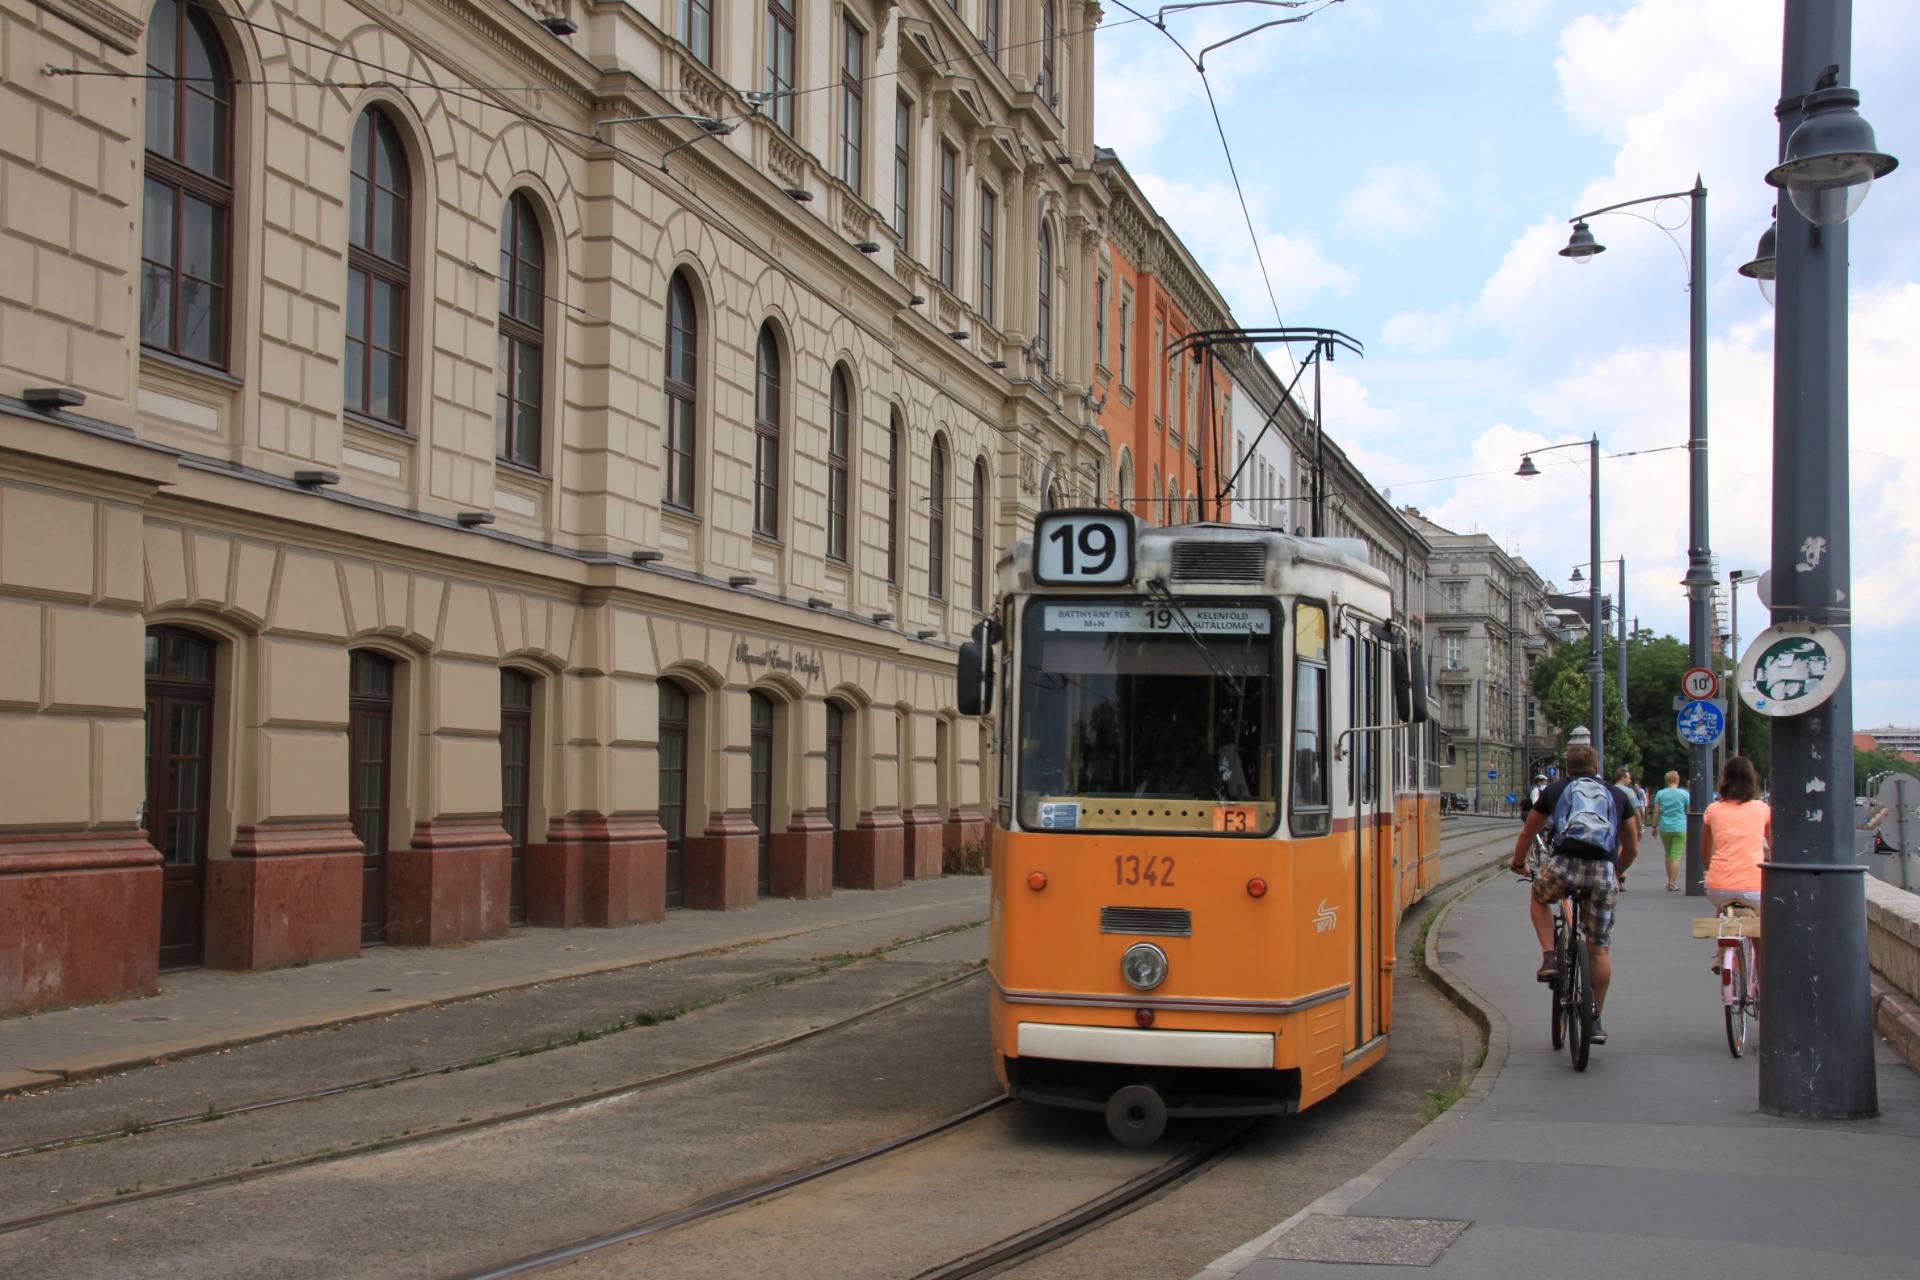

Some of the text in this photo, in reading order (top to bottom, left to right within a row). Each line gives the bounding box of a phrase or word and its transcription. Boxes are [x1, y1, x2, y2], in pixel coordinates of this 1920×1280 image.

[1049, 523, 1116, 575] 19
[1058, 610, 1130, 619] BATTHYÁNY TÉR
[1145, 609, 1172, 629] 19
[1197, 611, 1249, 620] KELENFÖLD
[1255, 622, 1264, 630] M
[1693, 678, 1706, 690] 10
[1224, 811, 1246, 832] F3
[1114, 855, 1176, 887] 1342
